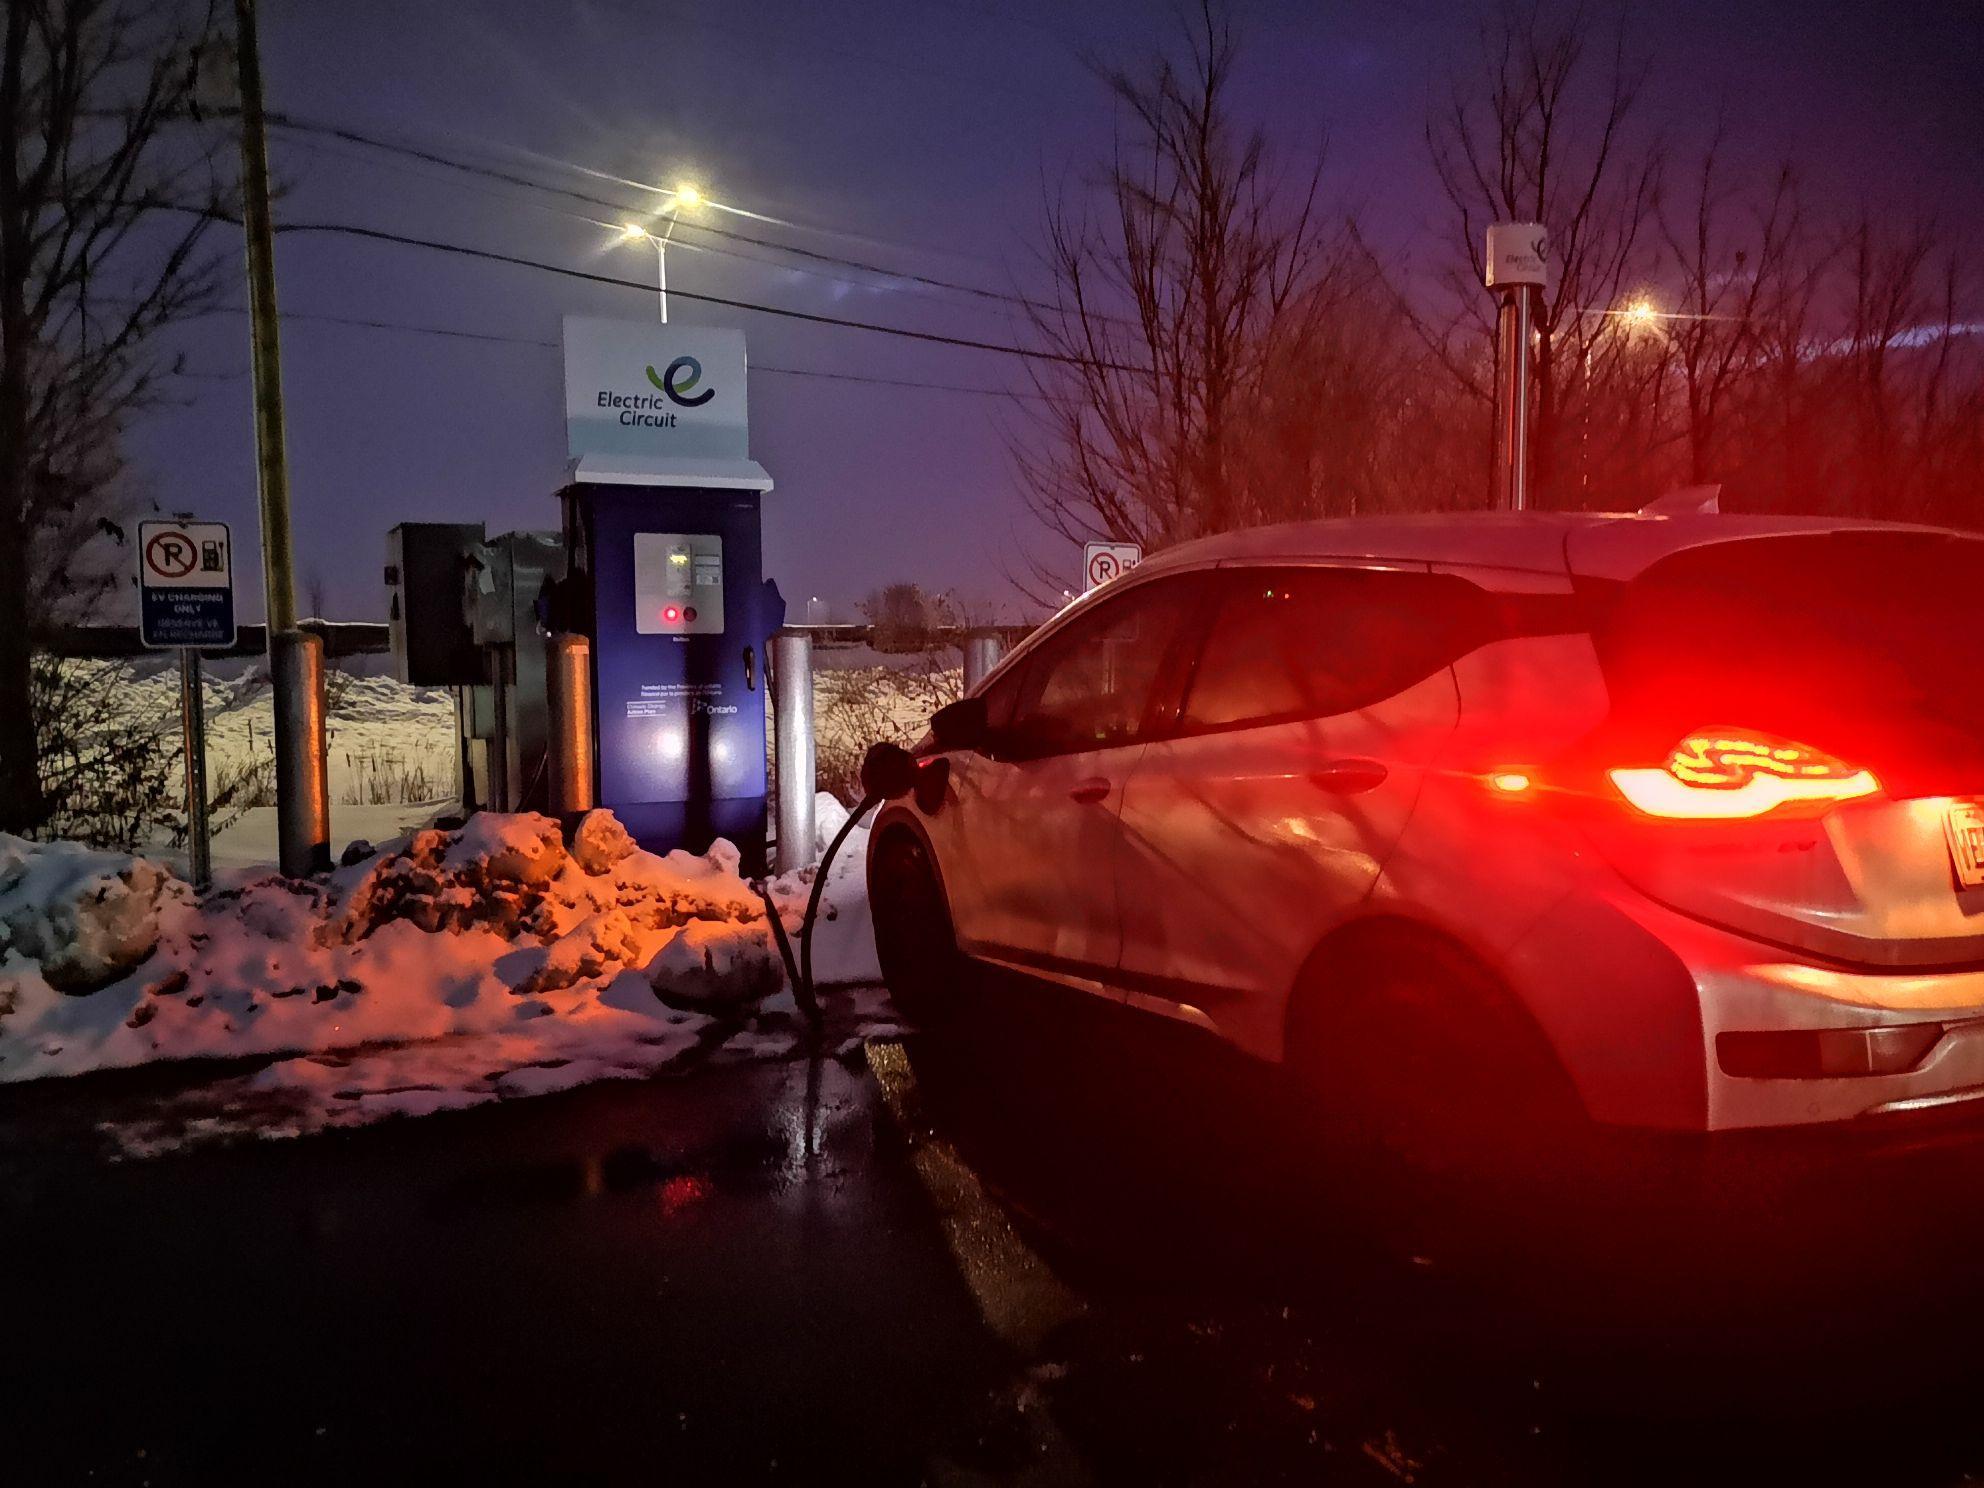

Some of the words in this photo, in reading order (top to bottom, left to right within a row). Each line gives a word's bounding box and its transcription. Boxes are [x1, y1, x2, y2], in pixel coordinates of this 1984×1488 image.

[597, 391, 664, 410] Electric
[619, 410, 677, 428] Circuit
[174, 603, 201, 615] ONLY
[706, 704, 738, 715] Ontario
